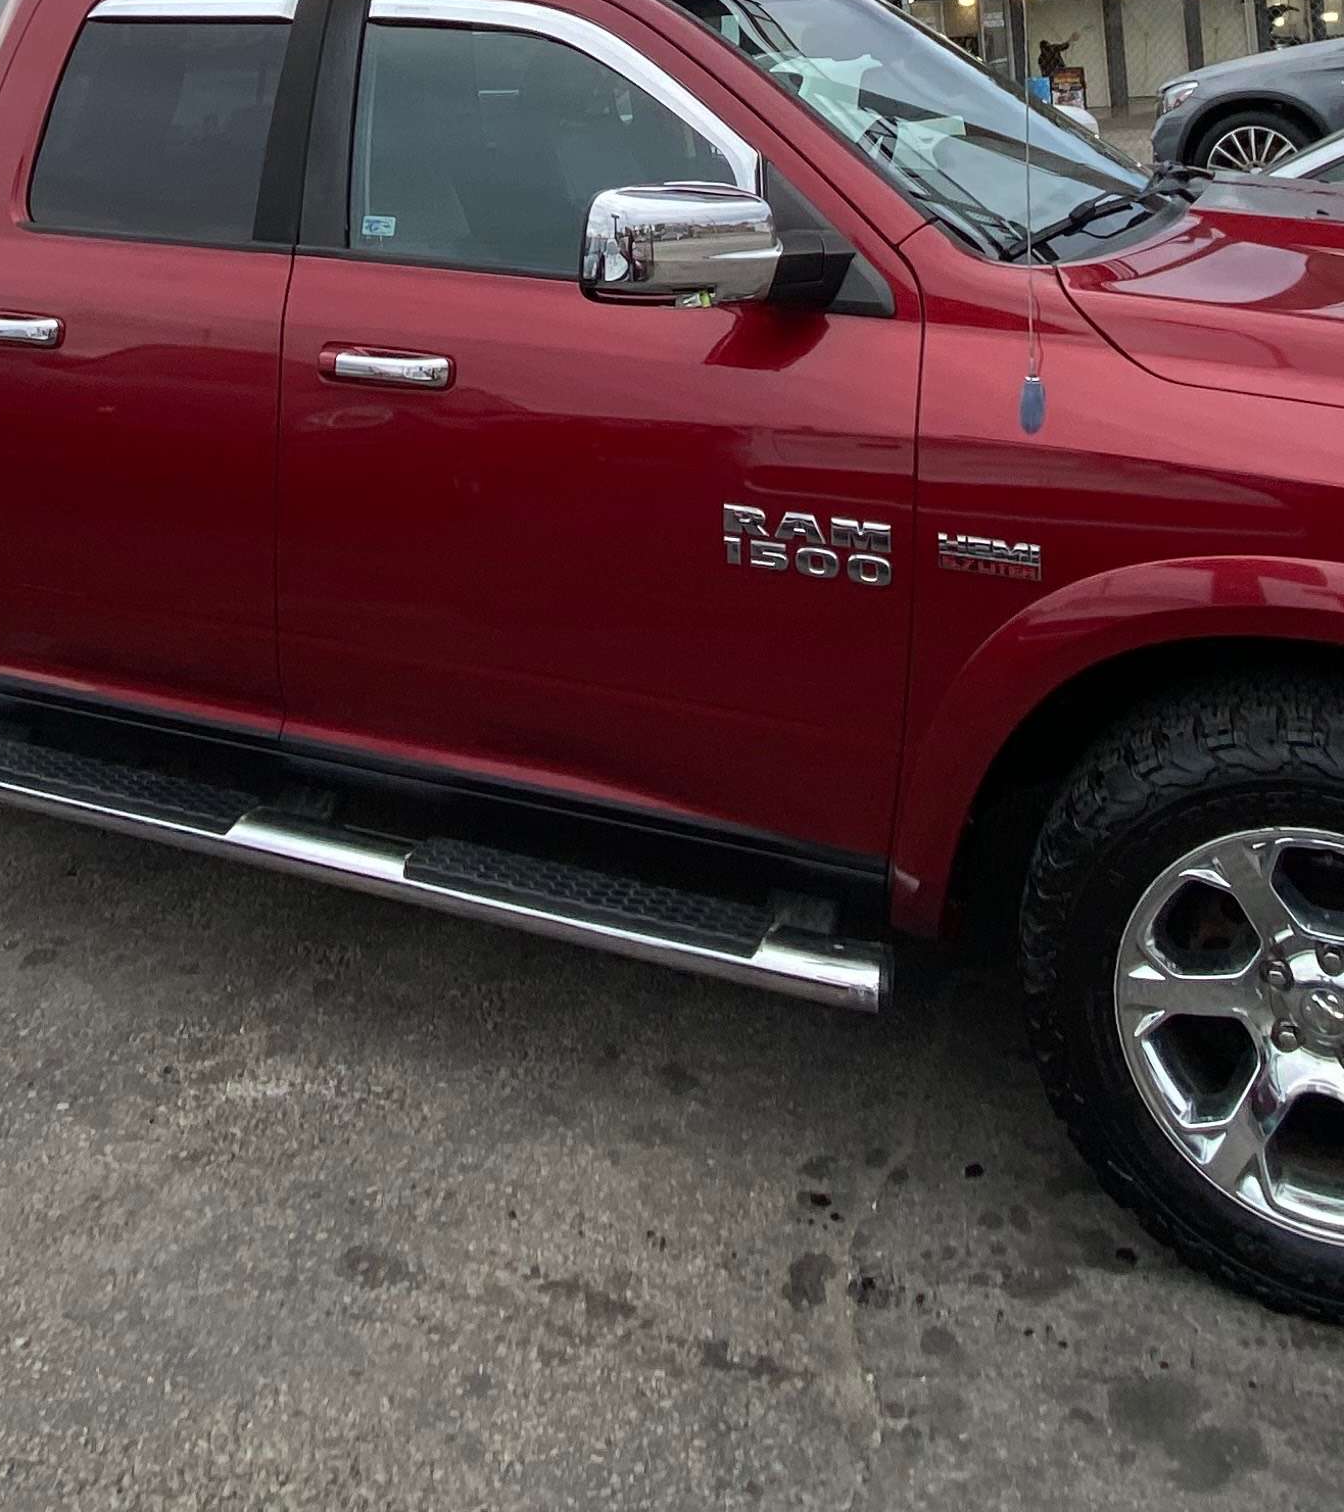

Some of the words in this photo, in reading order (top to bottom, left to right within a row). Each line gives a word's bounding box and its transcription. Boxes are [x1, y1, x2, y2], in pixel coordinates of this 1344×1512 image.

[723, 503, 892, 553] RAM
[938, 532, 1041, 565] HEMI
[723, 535, 892, 586] 1500
